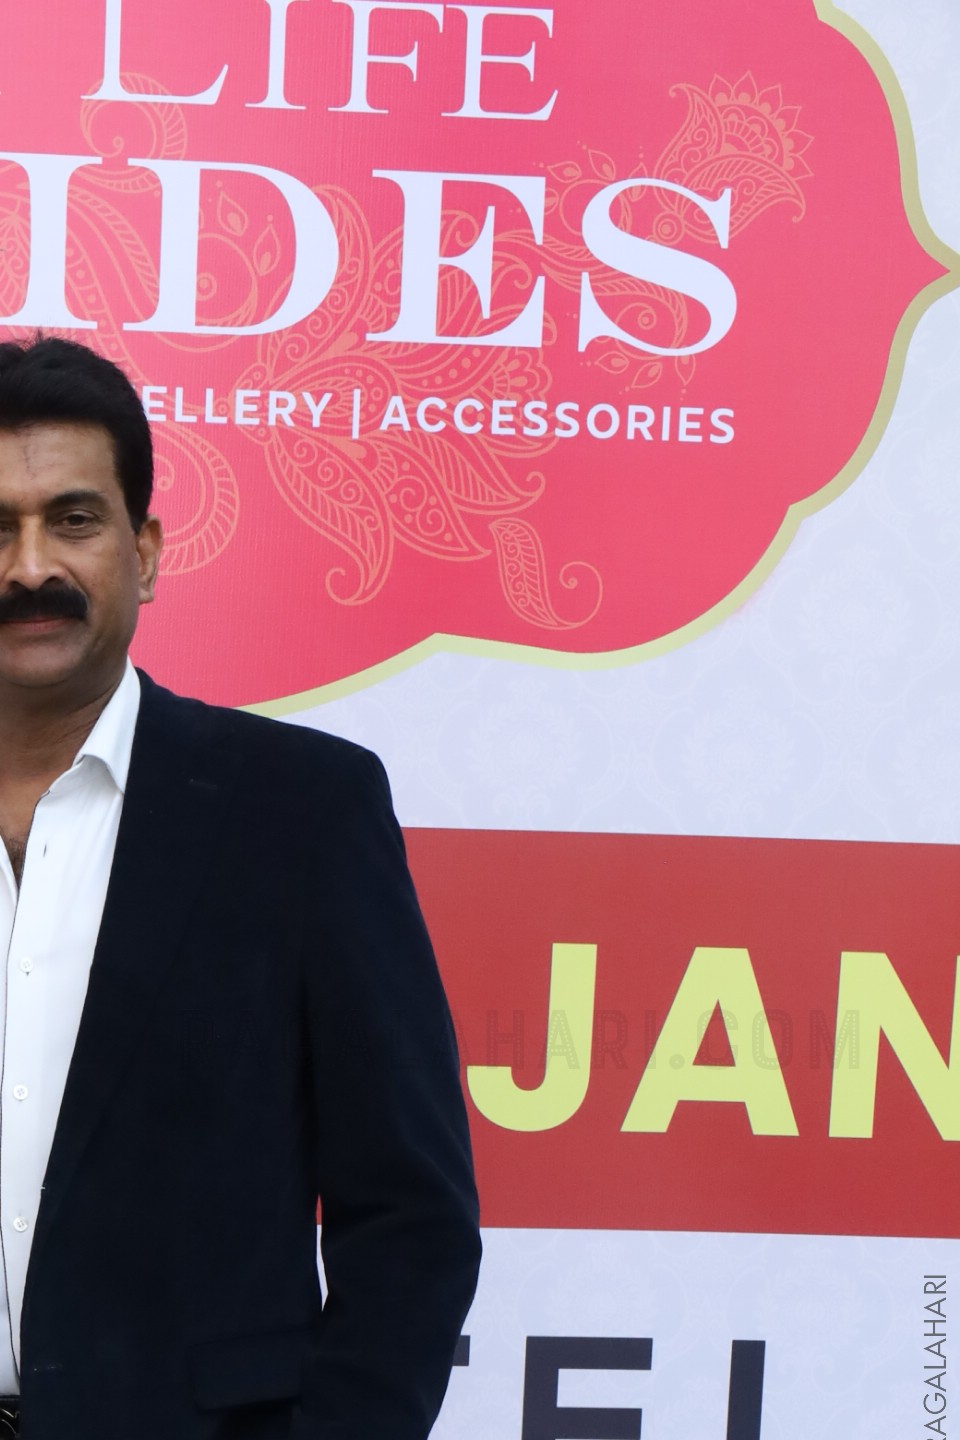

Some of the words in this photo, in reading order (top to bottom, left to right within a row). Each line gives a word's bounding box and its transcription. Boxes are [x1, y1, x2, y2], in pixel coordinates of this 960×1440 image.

[81, 0, 559, 121] LIFE
[131, 384, 334, 429] ELLERY
[379, 394, 736, 444] ACCESSORIES
[466, 942, 960, 1142] JAN
